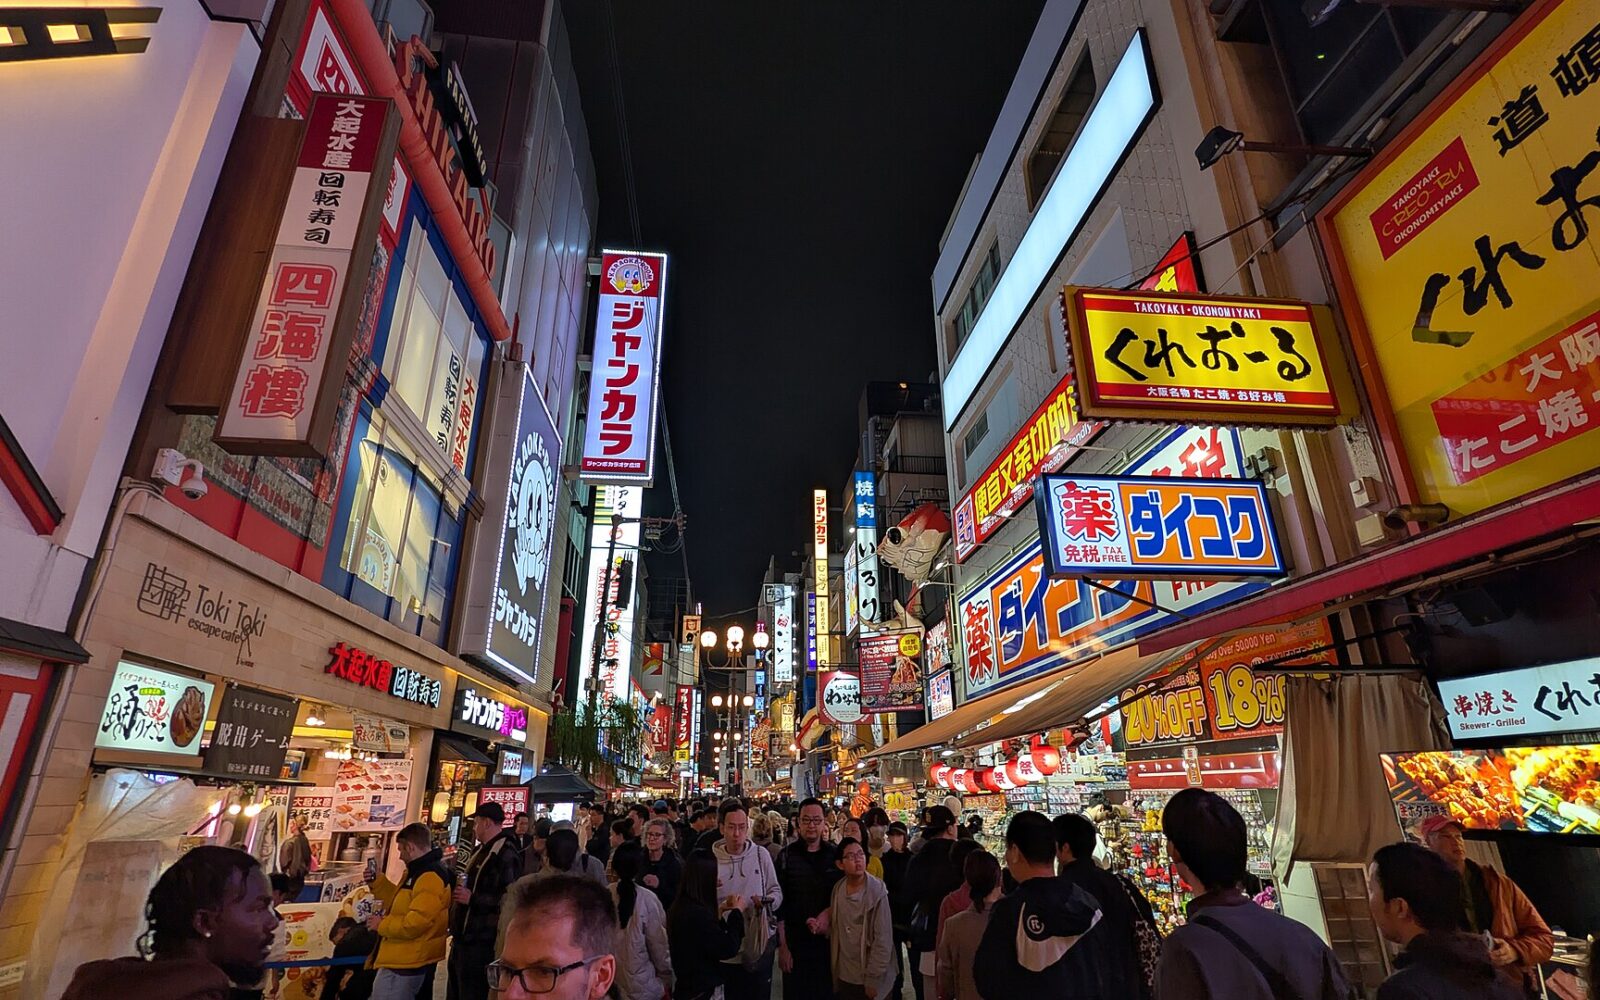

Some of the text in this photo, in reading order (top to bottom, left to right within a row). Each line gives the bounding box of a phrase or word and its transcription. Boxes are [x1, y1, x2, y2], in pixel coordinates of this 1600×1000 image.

[322, 100, 365, 170] 大起水産
[446, 67, 487, 178] PACHINKO
[303, 171, 345, 245] 回転寿司
[1392, 166, 1441, 211] TAKOYAKI
[1393, 183, 1464, 245] OKONOMIYAKI
[1104, 320, 1313, 383] くれおーる
[1519, 322, 1600, 393] 大阪
[599, 301, 645, 456] ジャンカラ
[1146, 387, 1191, 399] 大阪名物
[1455, 388, 1600, 473] たこ焼
[509, 431, 545, 529] KARAOKE
[855, 479, 876, 519] 焼肉
[815, 496, 827, 545] ジャンカラ
[1059, 486, 1118, 541] 薬
[1129, 490, 1264, 560] ダイコク
[1064, 545, 1100, 563] 免税
[1103, 546, 1122, 554] TAX
[858, 541, 877, 622] いろり
[188, 616, 241, 644] escape cafe
[194, 584, 268, 638] Toki Toki
[495, 588, 537, 648] ジャンカラ
[326, 642, 393, 693] 大起水産
[962, 601, 995, 686] 薬
[1218, 644, 1234, 658] Over
[1234, 635, 1259, 652] 50,000
[1259, 632, 1276, 645] Yen
[392, 667, 442, 709] 回転寿司
[462, 688, 505, 731] ジャンカラ
[1454, 690, 1518, 719] 串焼き
[215, 722, 289, 749] 脱出ゲーム
[1120, 684, 1207, 745] 20%OFF
[994, 771, 1006, 785] 祭
[1020, 761, 1033, 775] 祭
[485, 790, 525, 801] 大起水産
